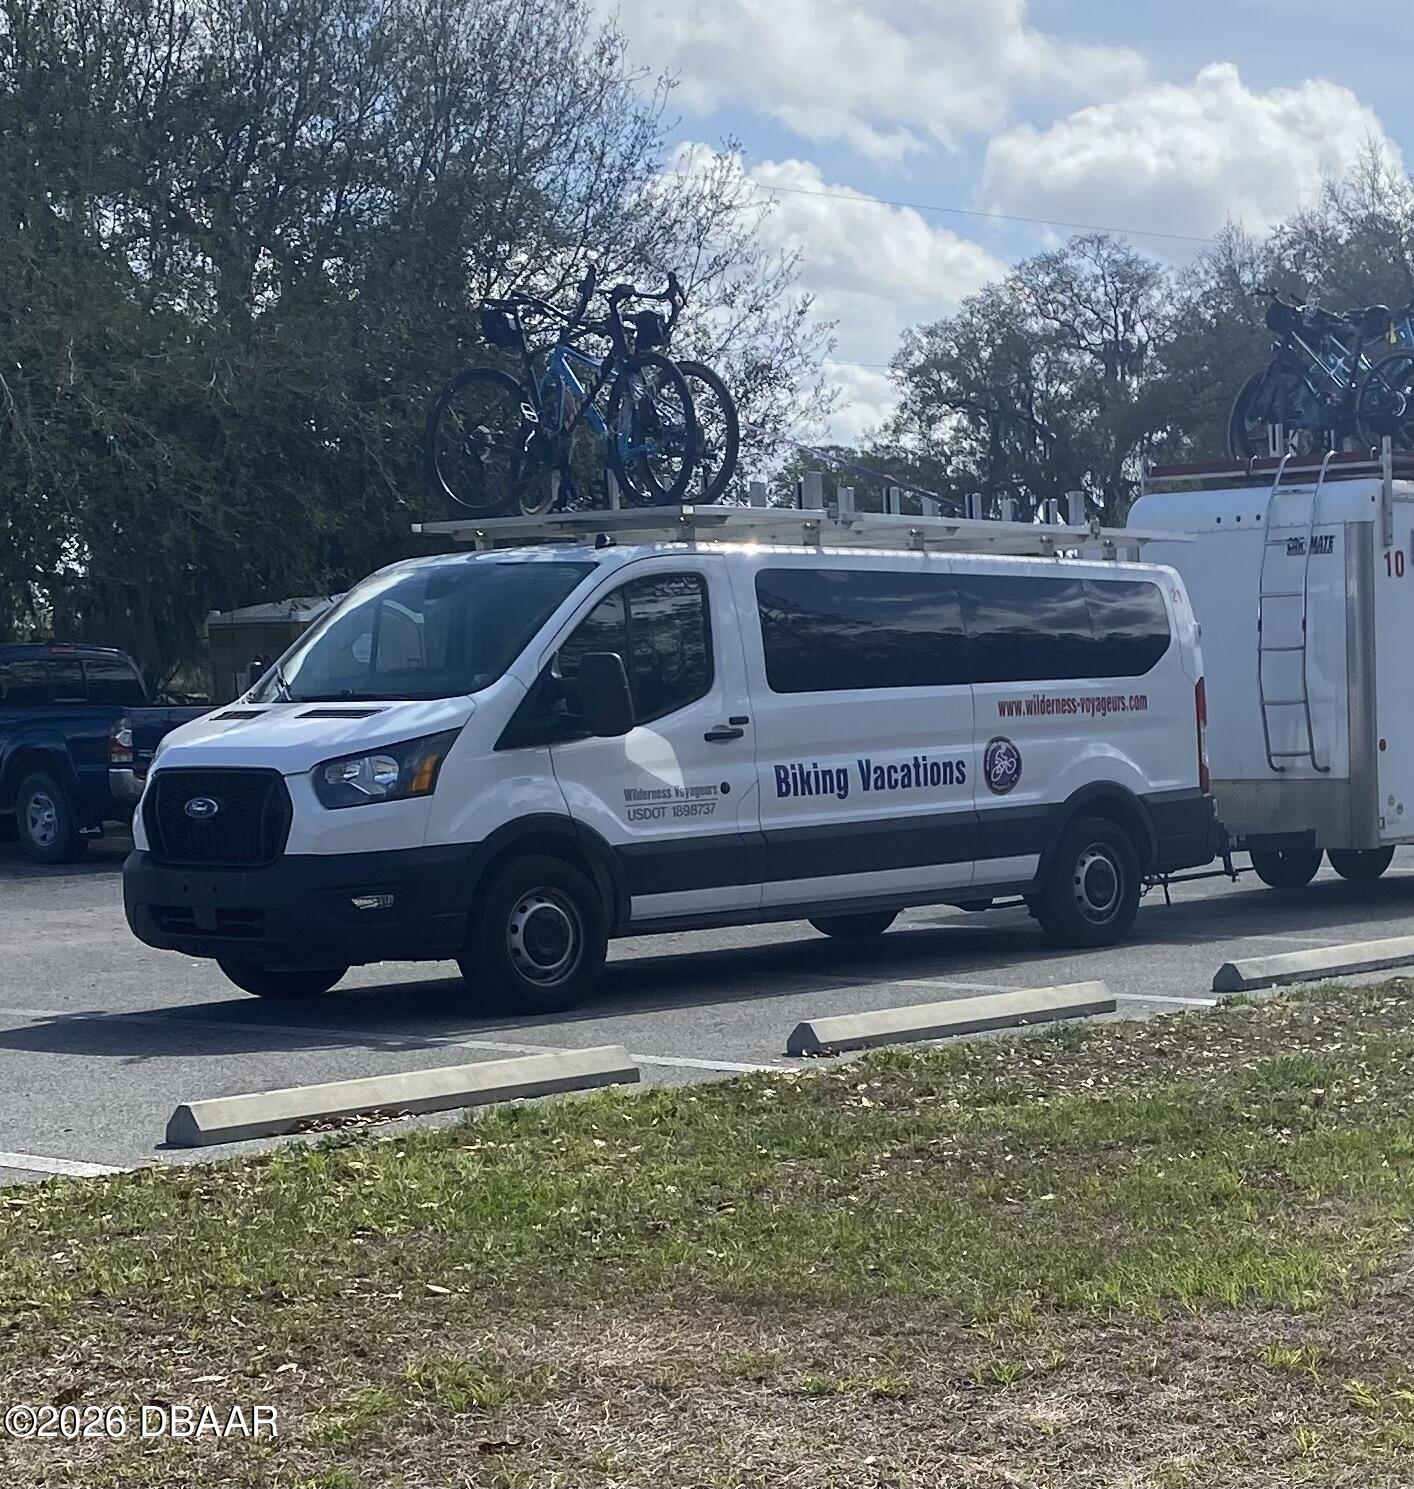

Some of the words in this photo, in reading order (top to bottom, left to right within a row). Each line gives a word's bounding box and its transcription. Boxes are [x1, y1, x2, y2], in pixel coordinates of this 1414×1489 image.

[1384, 550, 1405, 578] 10
[1170, 588, 1183, 603] 21
[997, 694, 1148, 718] www.wilderness-voyageurs.com
[774, 762, 849, 800] Biking
[857, 755, 966, 792] Vacations
[623, 787, 672, 801] Wilderness
[673, 785, 718, 799] Voyageurs
[627, 806, 667, 821] USDOT
[672, 802, 716, 817] 1898737
